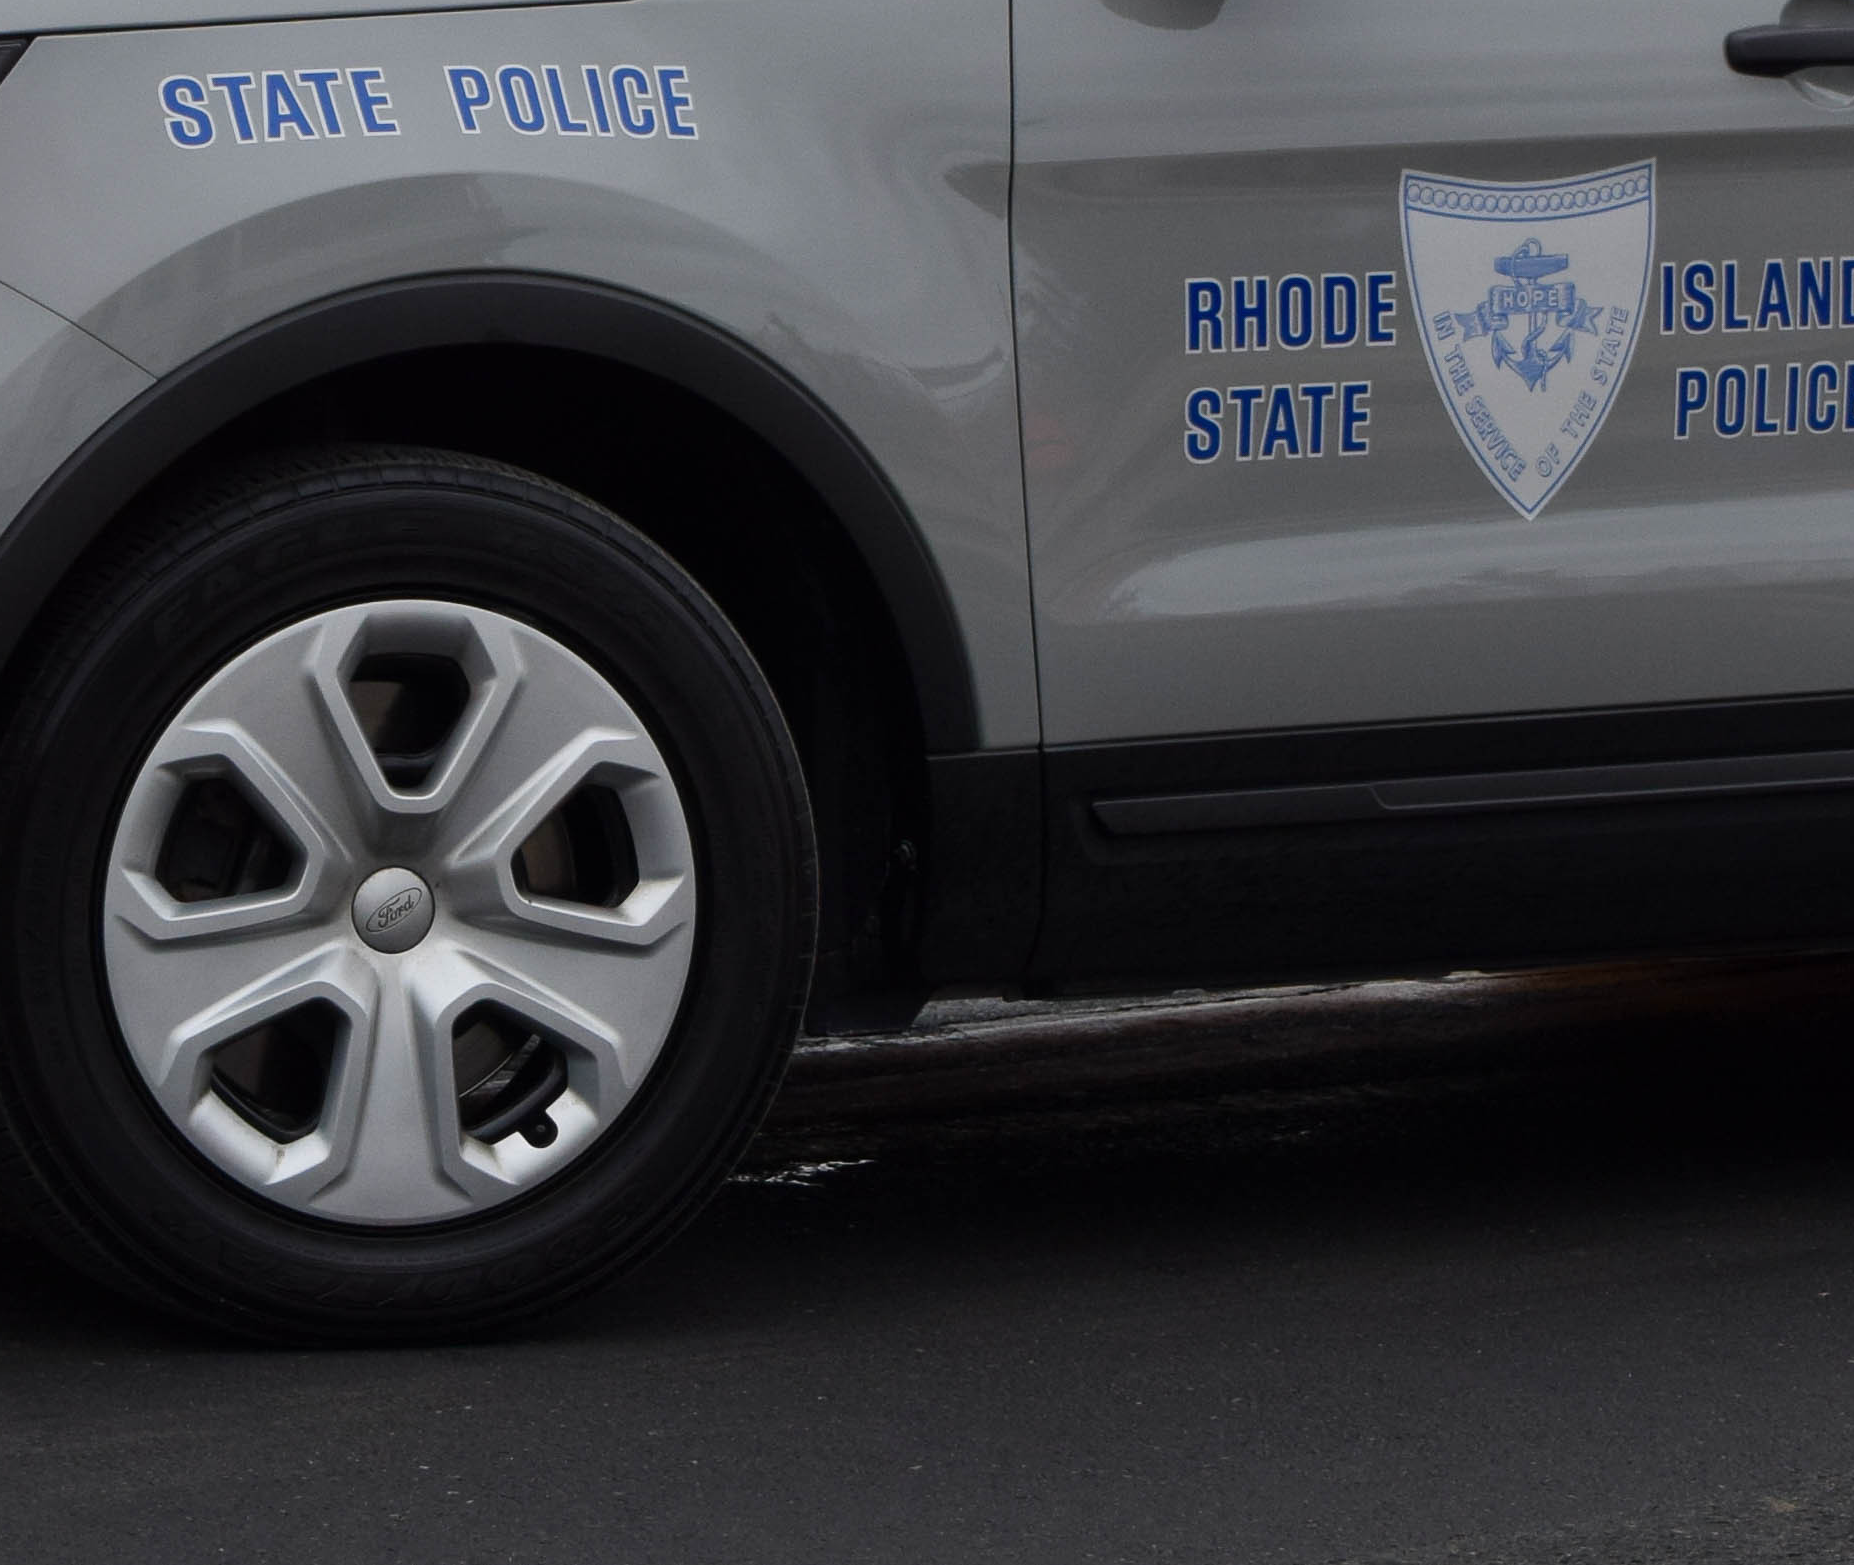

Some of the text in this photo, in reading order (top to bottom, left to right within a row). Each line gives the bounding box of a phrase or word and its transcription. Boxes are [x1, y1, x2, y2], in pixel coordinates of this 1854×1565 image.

[158, 64, 699, 150] STATE POLICE
[1185, 271, 1397, 354] RHODE
[1503, 290, 1560, 309] HOPE
[1184, 381, 1372, 464] STATE
[1433, 306, 1630, 482] IN THE SERVICE OF THE STATE
[377, 894, 415, 929] Ford
